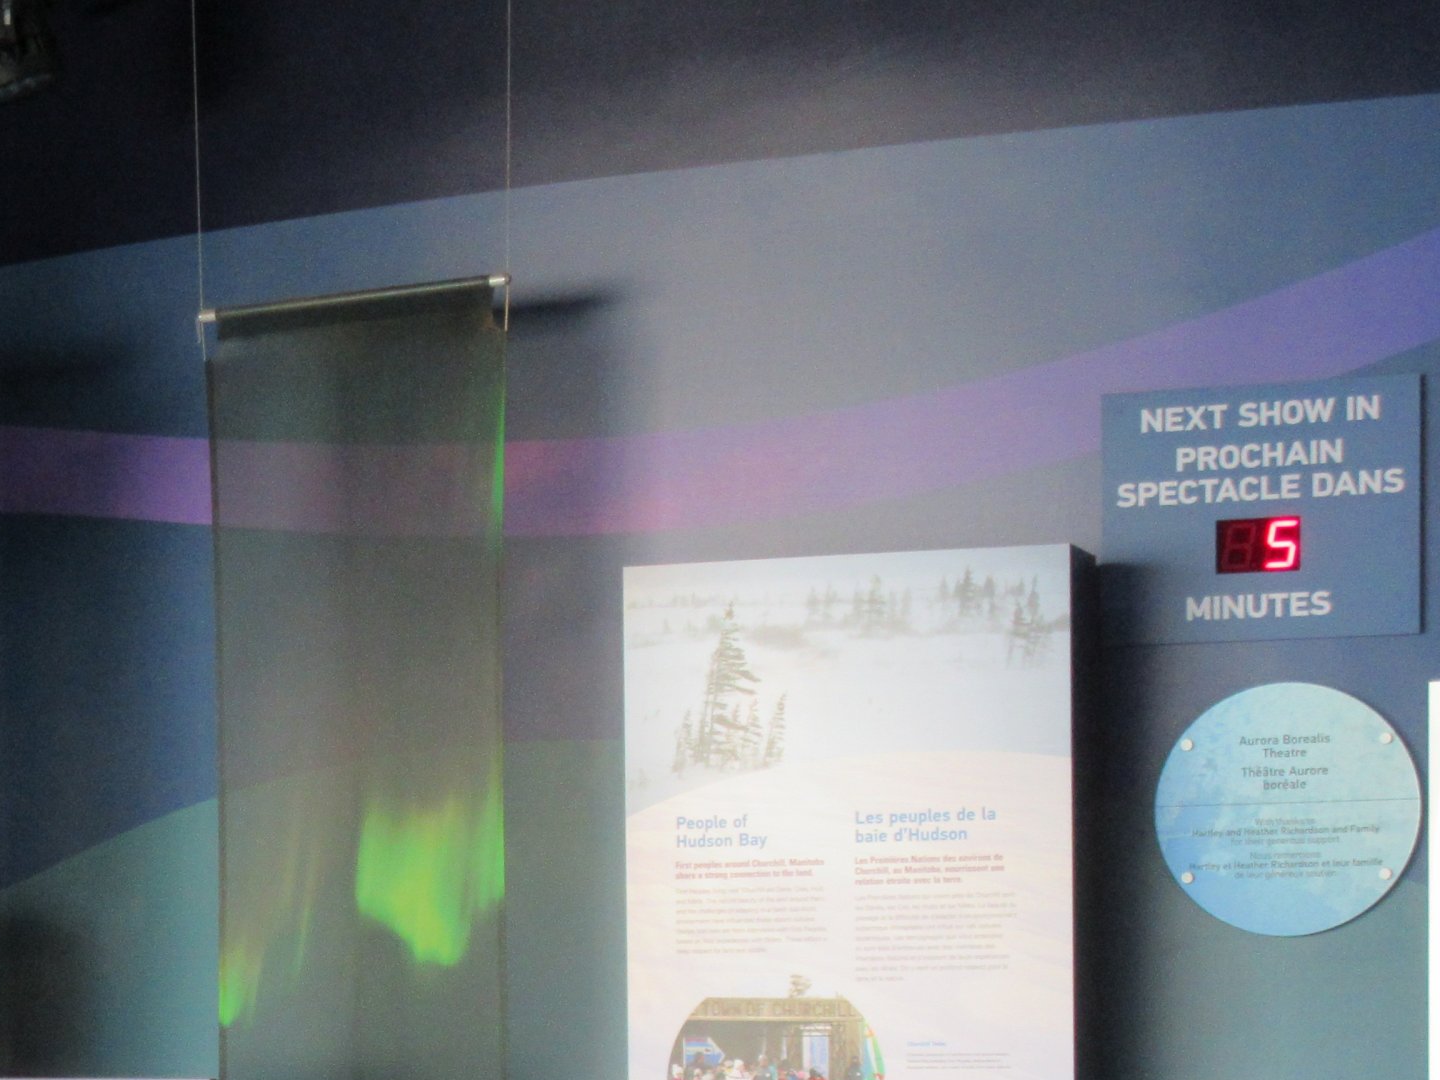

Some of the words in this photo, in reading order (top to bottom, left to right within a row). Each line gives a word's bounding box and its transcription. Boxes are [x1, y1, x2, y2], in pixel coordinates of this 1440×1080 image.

[1140, 404, 1228, 433] NEXT
[1238, 397, 1335, 427] SHOW
[1346, 395, 1381, 421] IN
[1176, 438, 1344, 472] PROCHAIN
[1117, 473, 1301, 507] SPECTACLE
[1312, 468, 1405, 497] DANS
[1264, 519, 1299, 569] 5
[1186, 590, 1332, 620] MINUTES
[1239, 735, 1279, 746] Aurora
[1282, 733, 1331, 745] Borealis
[1263, 748, 1308, 758] Theatre
[1241, 766, 1285, 777] Théâtre
[1289, 766, 1329, 776] Aurore
[1263, 779, 1307, 790] boréale
[676, 815, 727, 832] People
[733, 814, 748, 828] of
[855, 811, 884, 825] Les
[889, 808, 951, 827] peuples
[956, 807, 976, 821] de
[981, 806, 997, 820] la
[676, 834, 733, 848] Hudson
[739, 833, 768, 849] Bay
[855, 829, 888, 843] baie
[894, 827, 968, 842] d'Hudson
